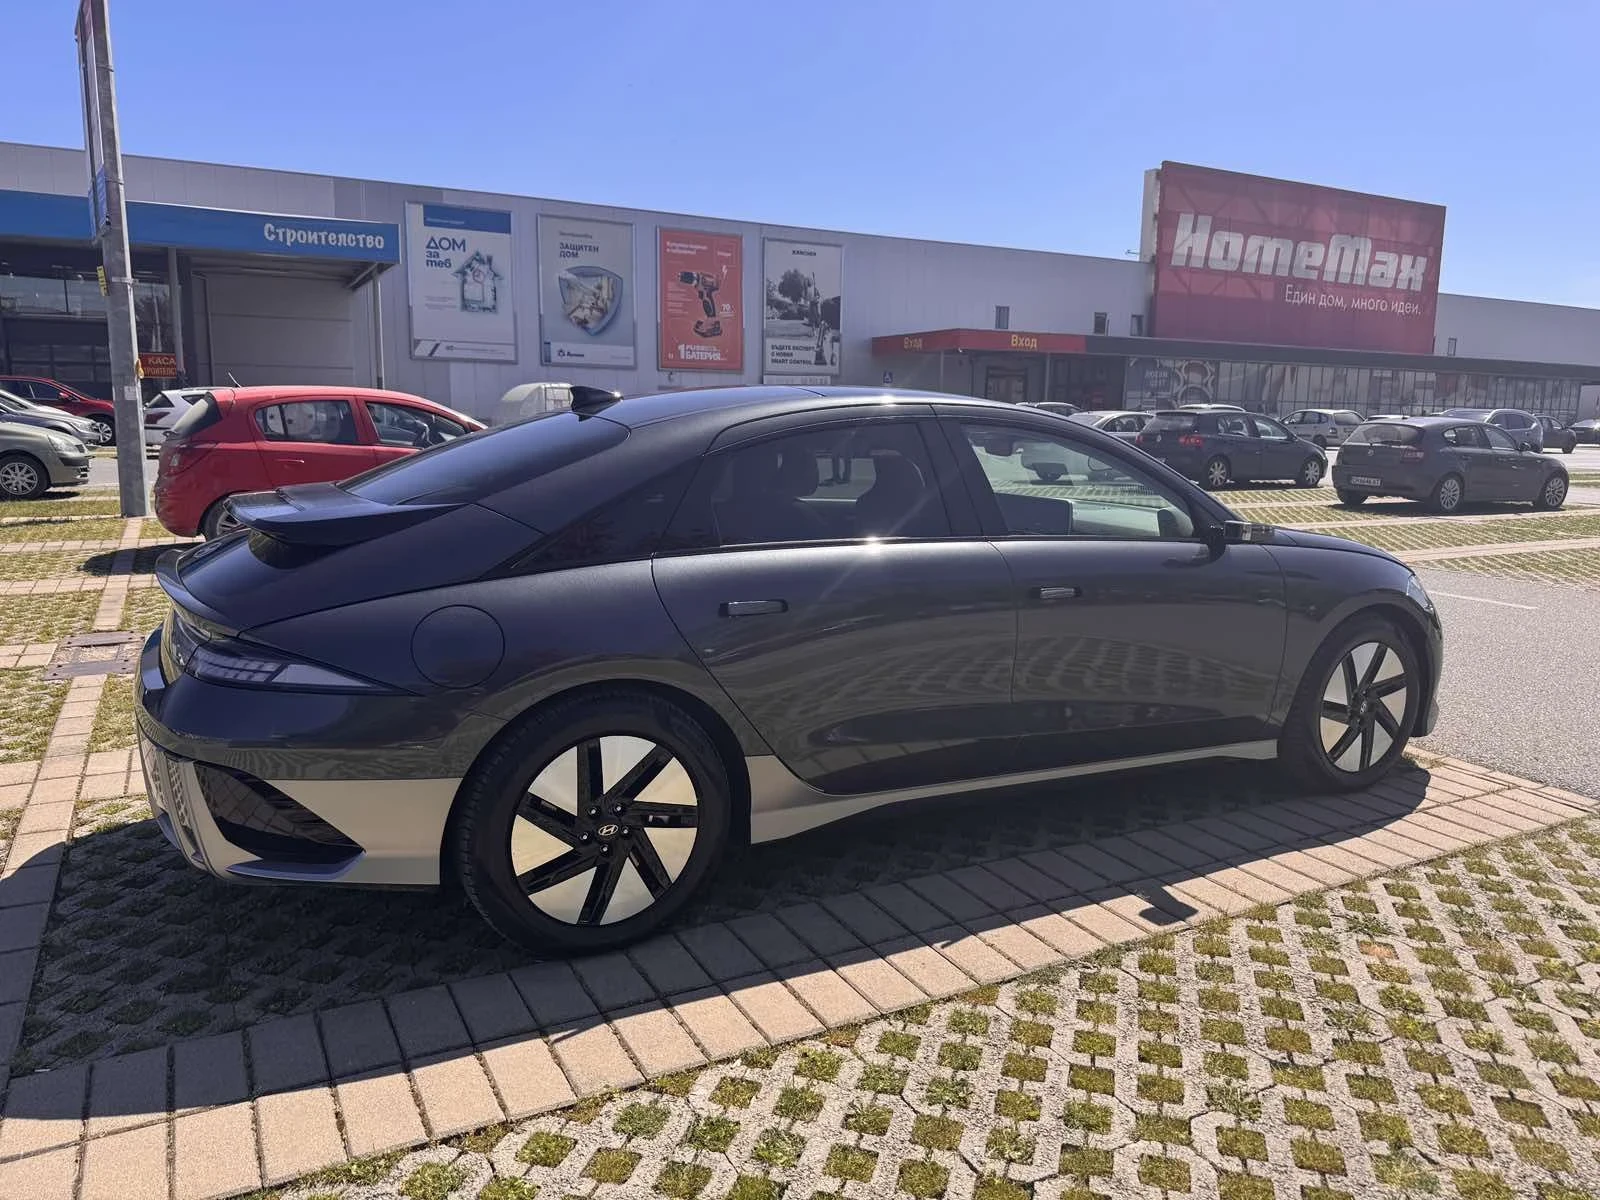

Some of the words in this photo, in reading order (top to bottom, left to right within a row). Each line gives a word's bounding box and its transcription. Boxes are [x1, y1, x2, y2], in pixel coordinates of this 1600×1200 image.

[263, 223, 385, 249] Строителство
[425, 236, 466, 253] ДОМ
[559, 242, 600, 253] ЗАЩИТЕН
[425, 251, 440, 259] за
[1170, 213, 1428, 292] HomeMax
[1285, 284, 1317, 305] Един
[1319, 293, 1348, 311] дом,
[1351, 297, 1388, 312] много
[1391, 302, 1422, 316] идеи.
[903, 336, 923, 350] Вход
[1011, 334, 1038, 349] Вход
[148, 356, 176, 366] КАСА
